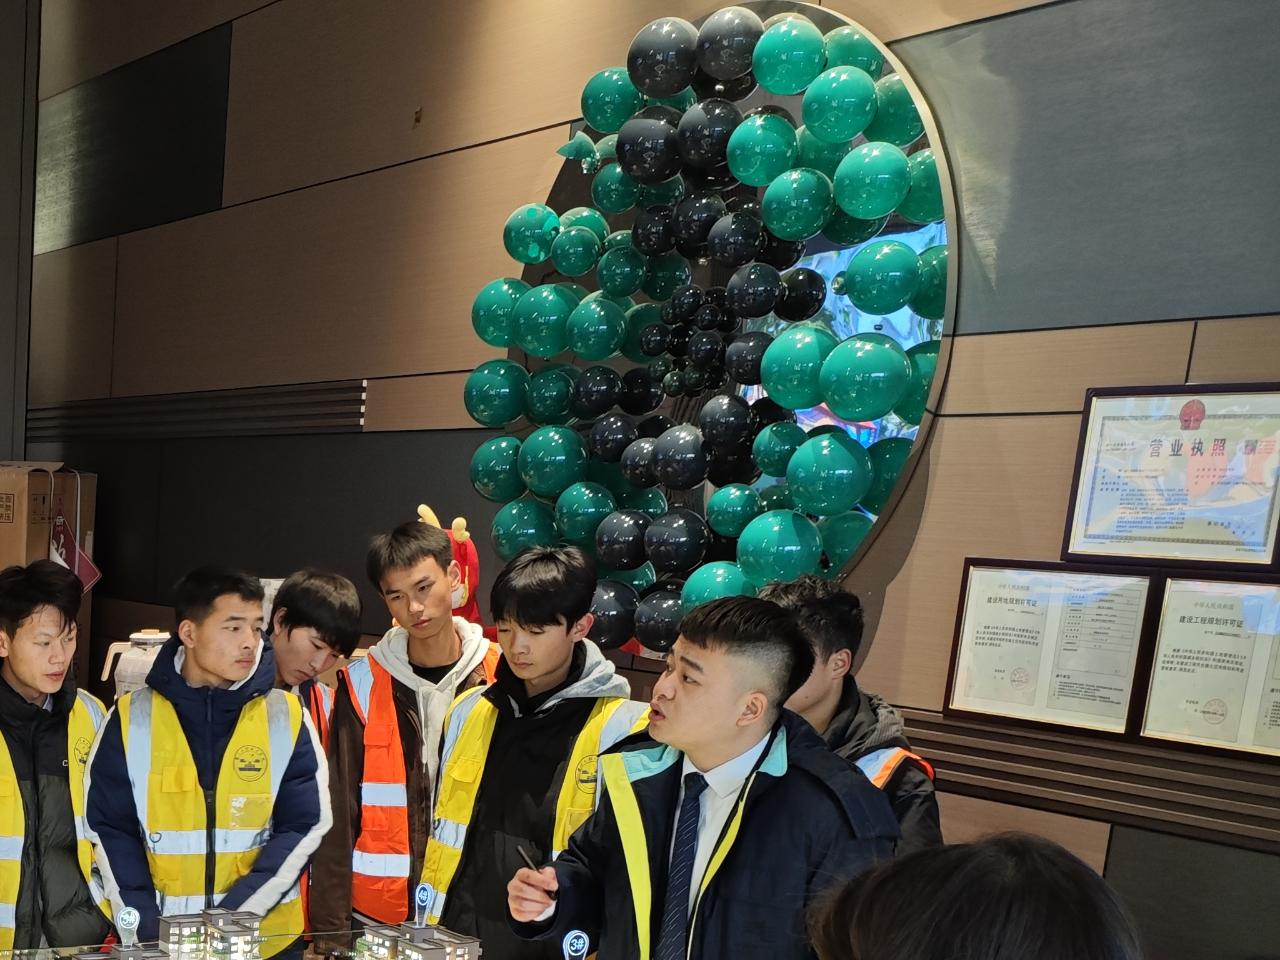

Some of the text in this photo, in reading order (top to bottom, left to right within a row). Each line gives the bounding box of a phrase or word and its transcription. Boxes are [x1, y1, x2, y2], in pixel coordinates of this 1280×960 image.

[1150, 438, 1227, 458] 营业执照
[1179, 615, 1244, 629] 建设工程规划许可证
[570, 938, 585, 951] 3#
